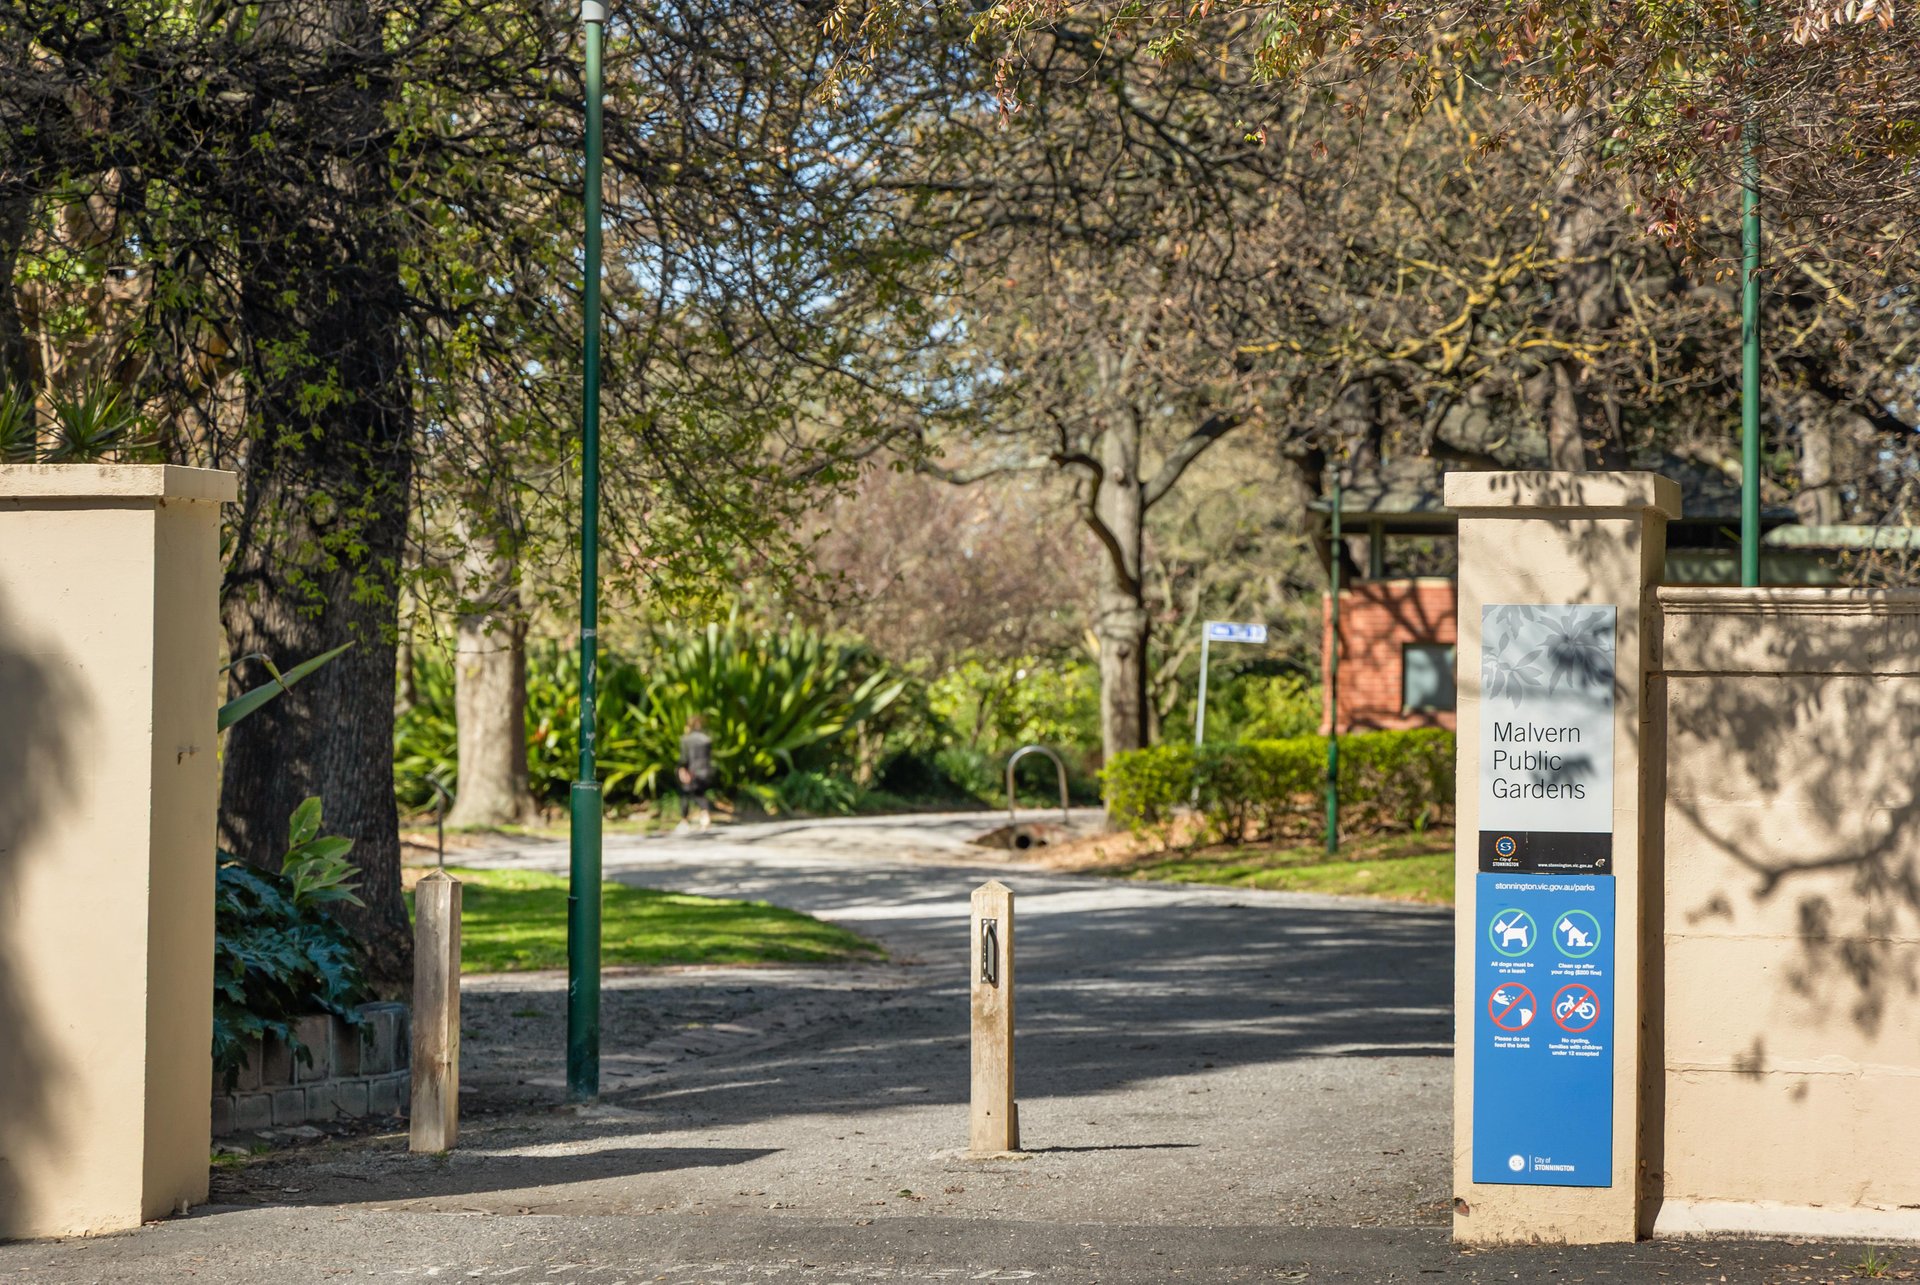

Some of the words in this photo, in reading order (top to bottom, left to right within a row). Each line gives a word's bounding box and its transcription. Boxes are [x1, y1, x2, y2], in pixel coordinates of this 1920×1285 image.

[1494, 722, 1581, 742] Malvern
[1493, 750, 1562, 771] Public
[1492, 778, 1585, 799] Gardens
[1495, 882, 1596, 892] stonnington.vic.gov.au/parks
